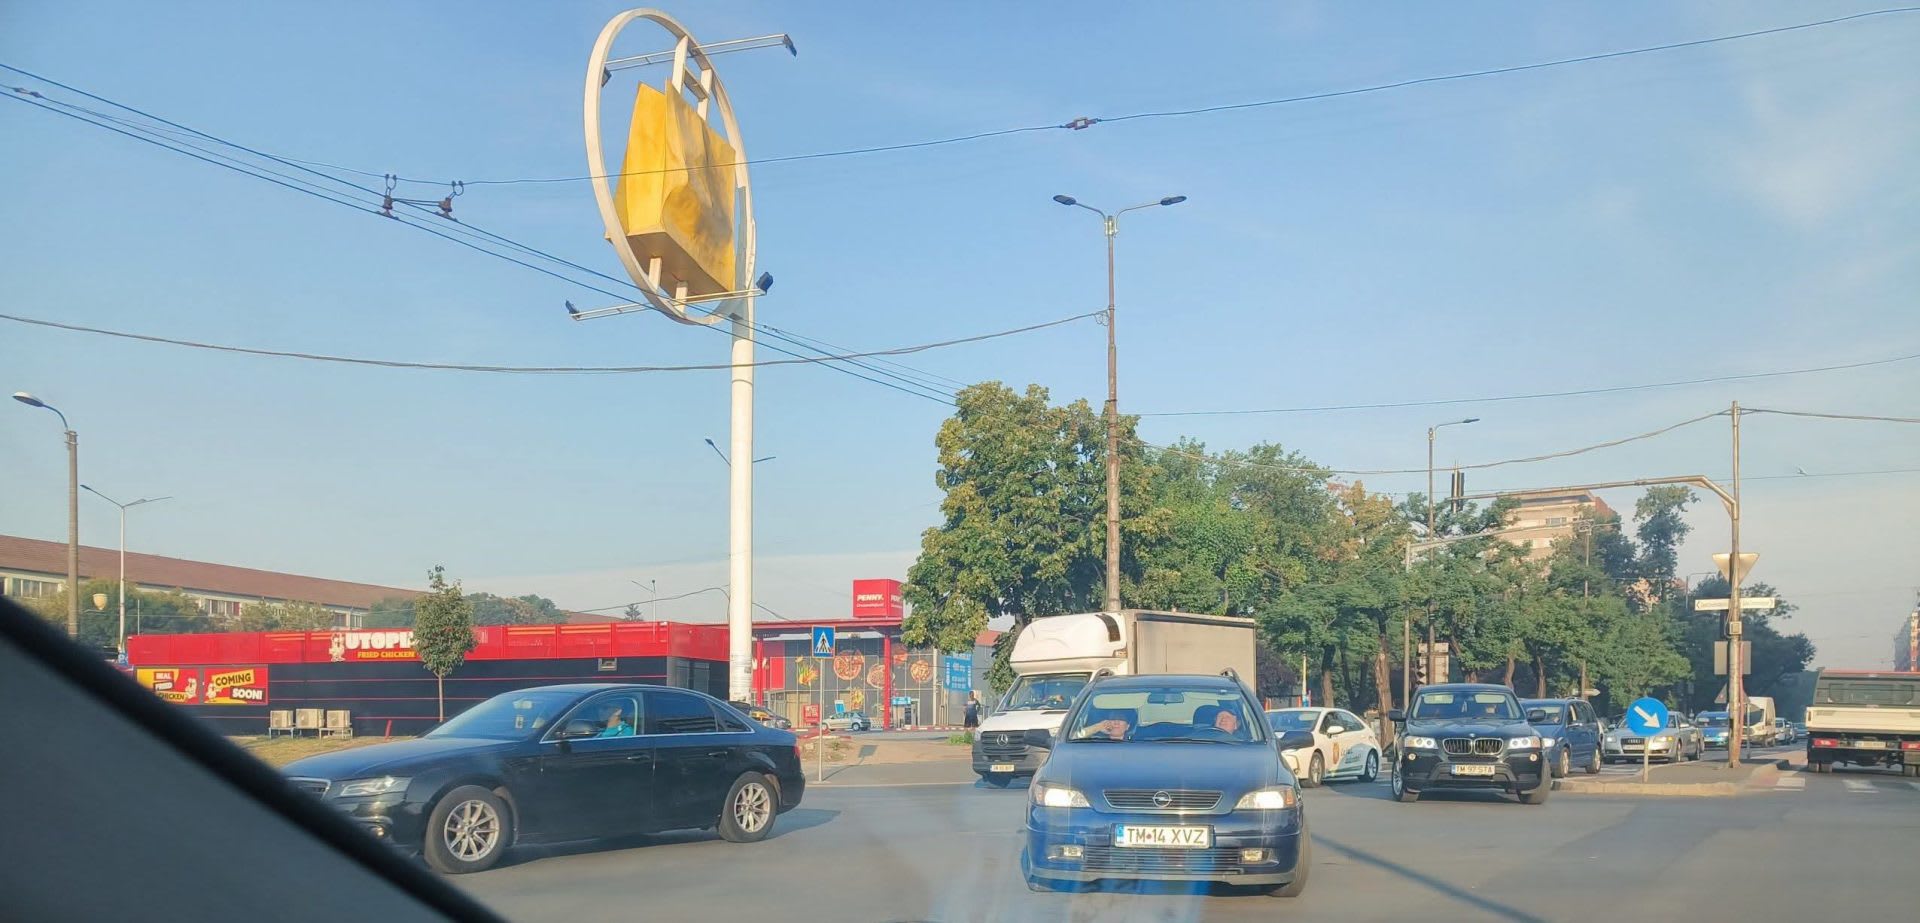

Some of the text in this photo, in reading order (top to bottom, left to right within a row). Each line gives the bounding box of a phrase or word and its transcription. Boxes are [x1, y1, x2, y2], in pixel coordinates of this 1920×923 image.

[357, 651, 416, 659] FRIED CHICKEN
[215, 673, 252, 687] COMING
[232, 688, 263, 700] SOON!
[1171, 829, 1205, 844] XVZ
